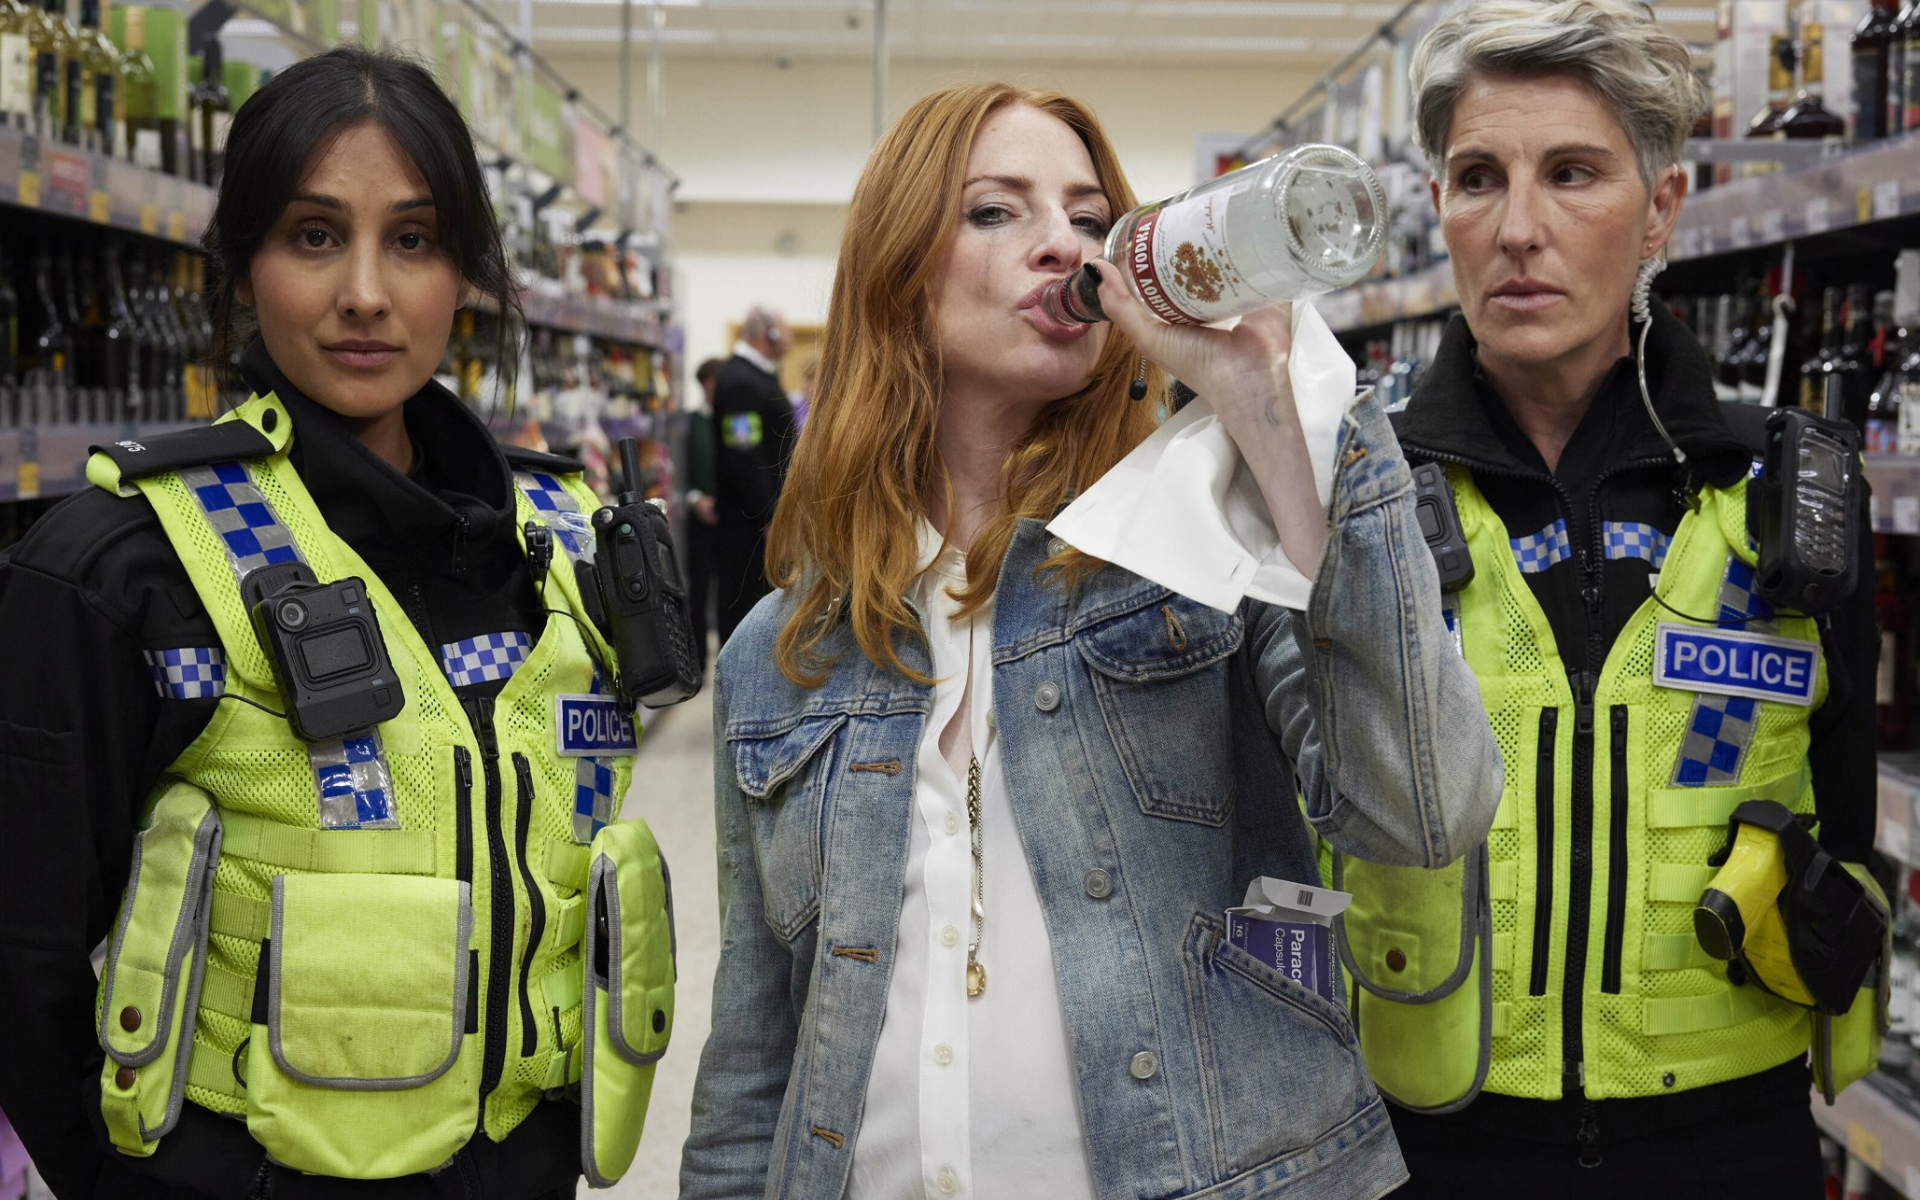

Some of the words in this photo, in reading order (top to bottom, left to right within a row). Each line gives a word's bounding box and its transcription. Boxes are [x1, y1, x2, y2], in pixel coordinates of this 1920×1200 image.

[1134, 221, 1152, 274] VODKA
[1140, 278, 1197, 326] ALAKHOV
[1673, 640, 1807, 689] POLICE
[568, 708, 632, 742] POLICE
[1236, 924, 1243, 938] 16
